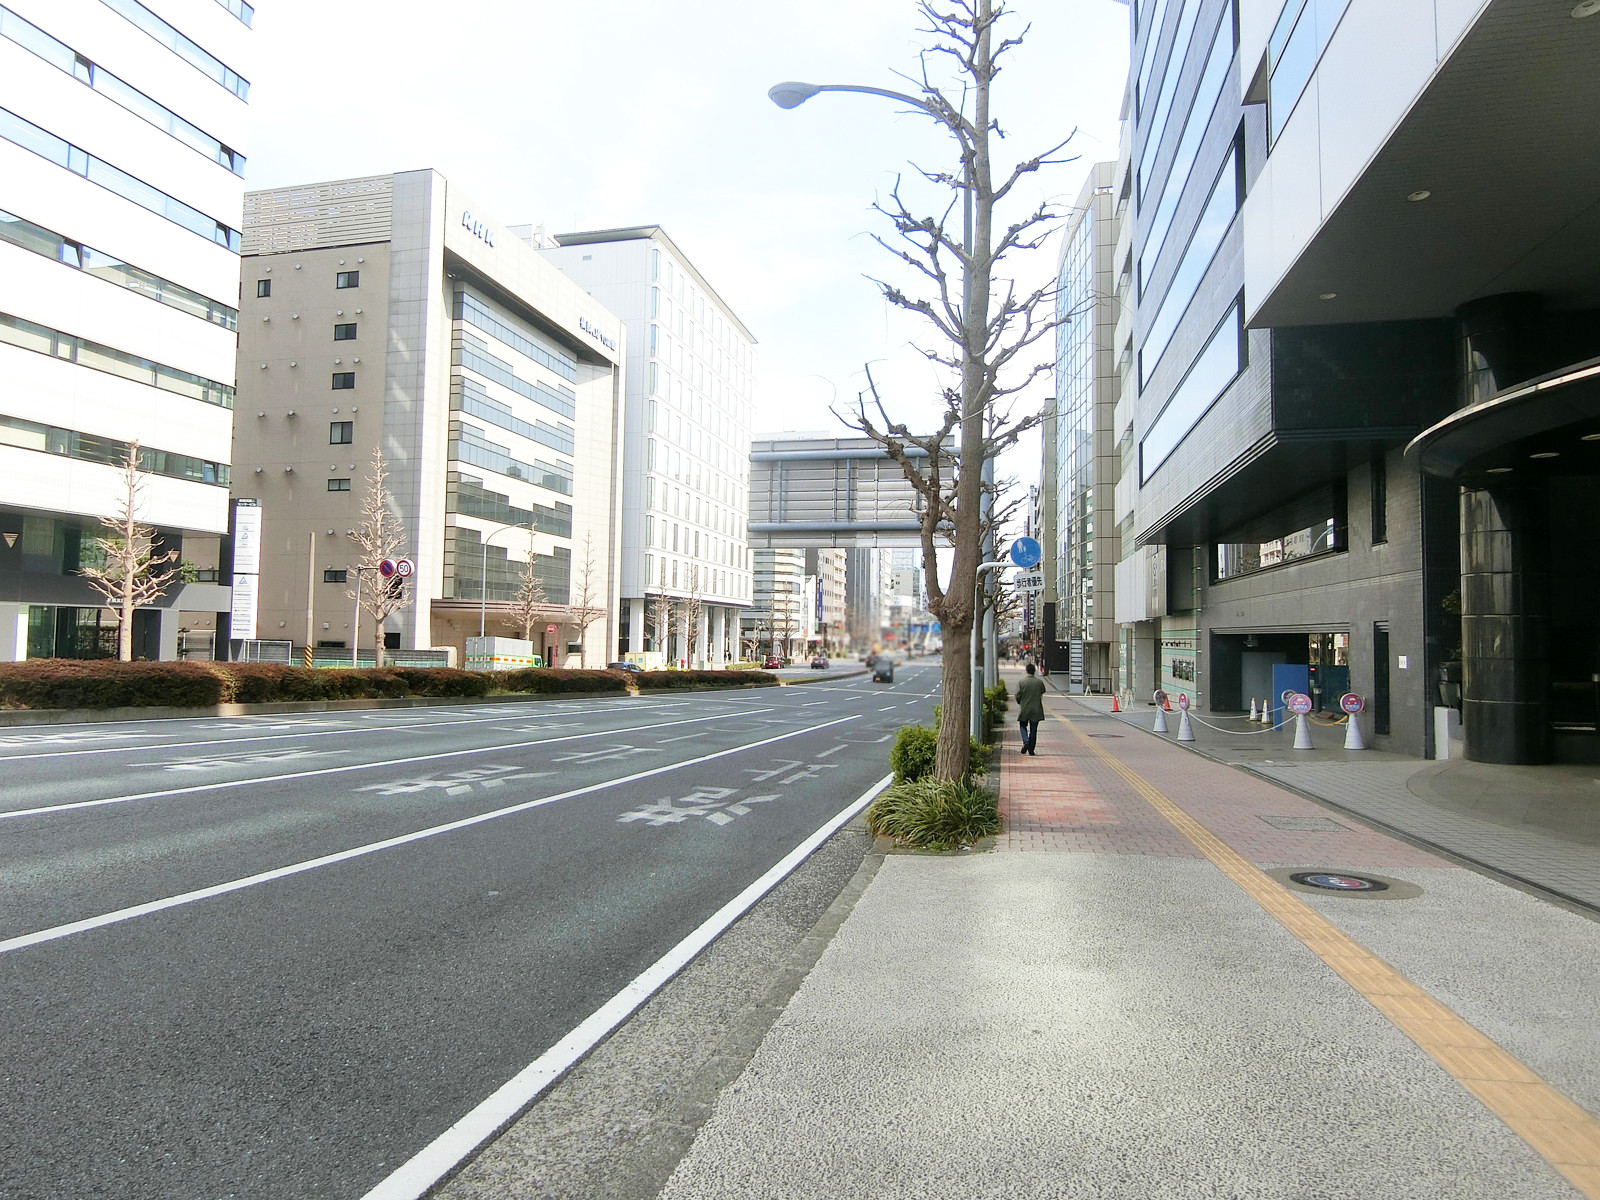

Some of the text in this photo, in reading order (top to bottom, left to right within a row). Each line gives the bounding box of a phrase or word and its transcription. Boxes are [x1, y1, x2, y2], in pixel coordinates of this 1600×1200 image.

[399, 564, 409, 573] 50
[1016, 576, 1043, 589] 歩行者優先
